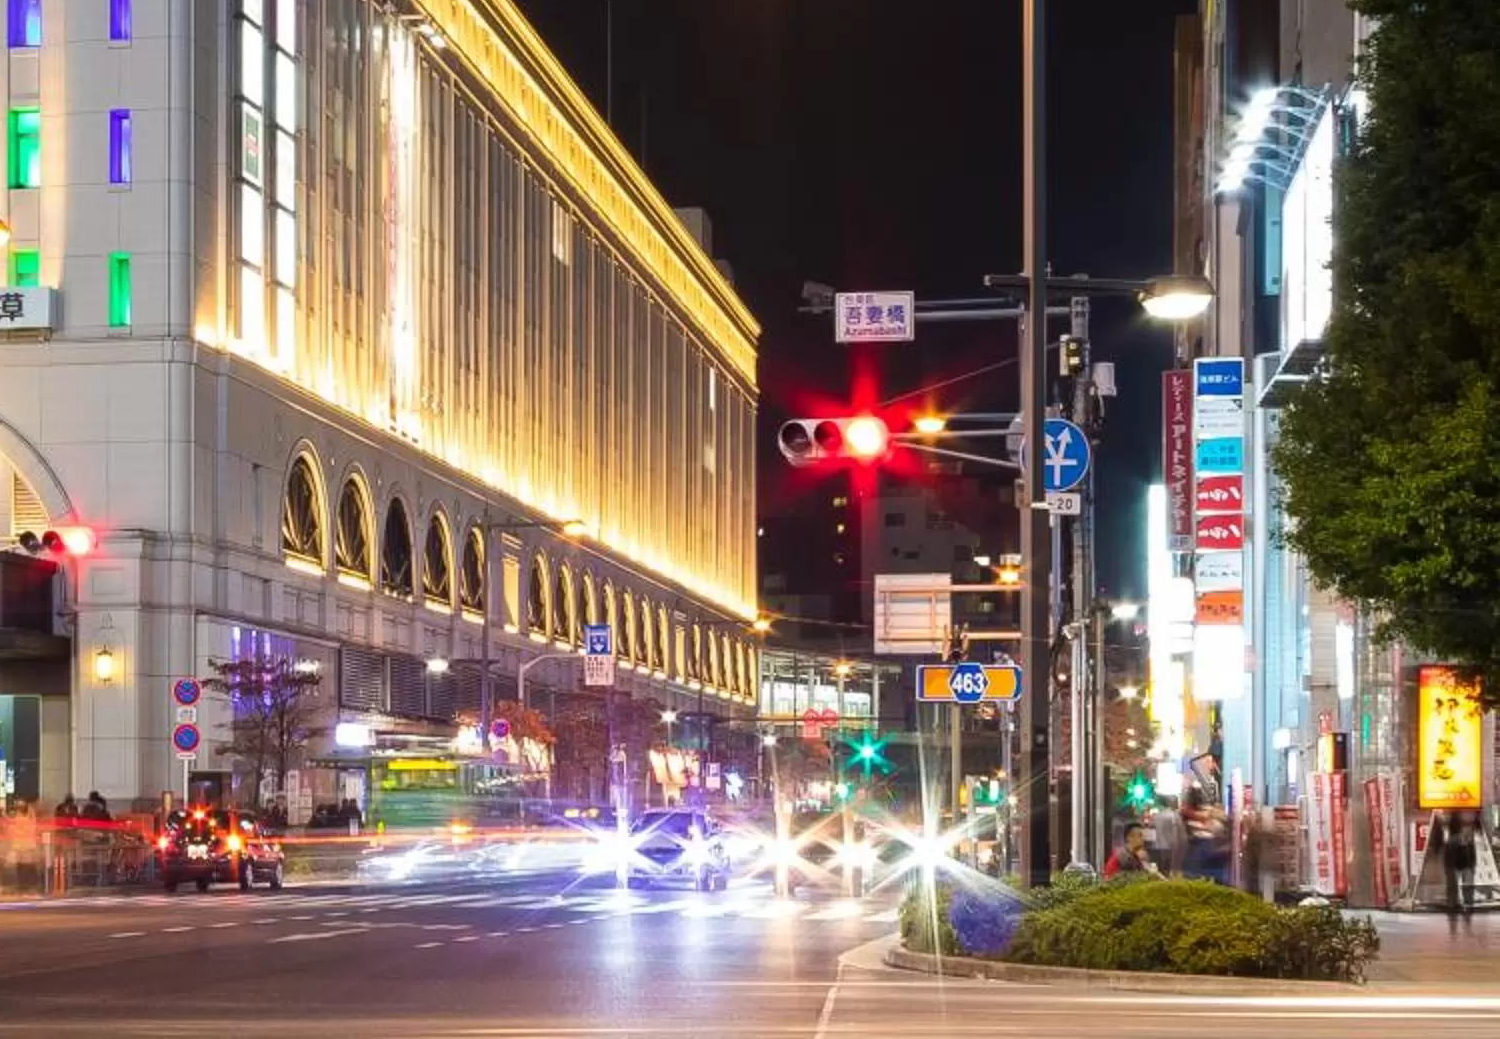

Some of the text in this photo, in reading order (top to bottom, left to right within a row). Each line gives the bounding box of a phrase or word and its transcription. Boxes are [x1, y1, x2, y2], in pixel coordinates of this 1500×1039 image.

[844, 305, 905, 325] 吾妻橋
[951, 672, 985, 694] 463
